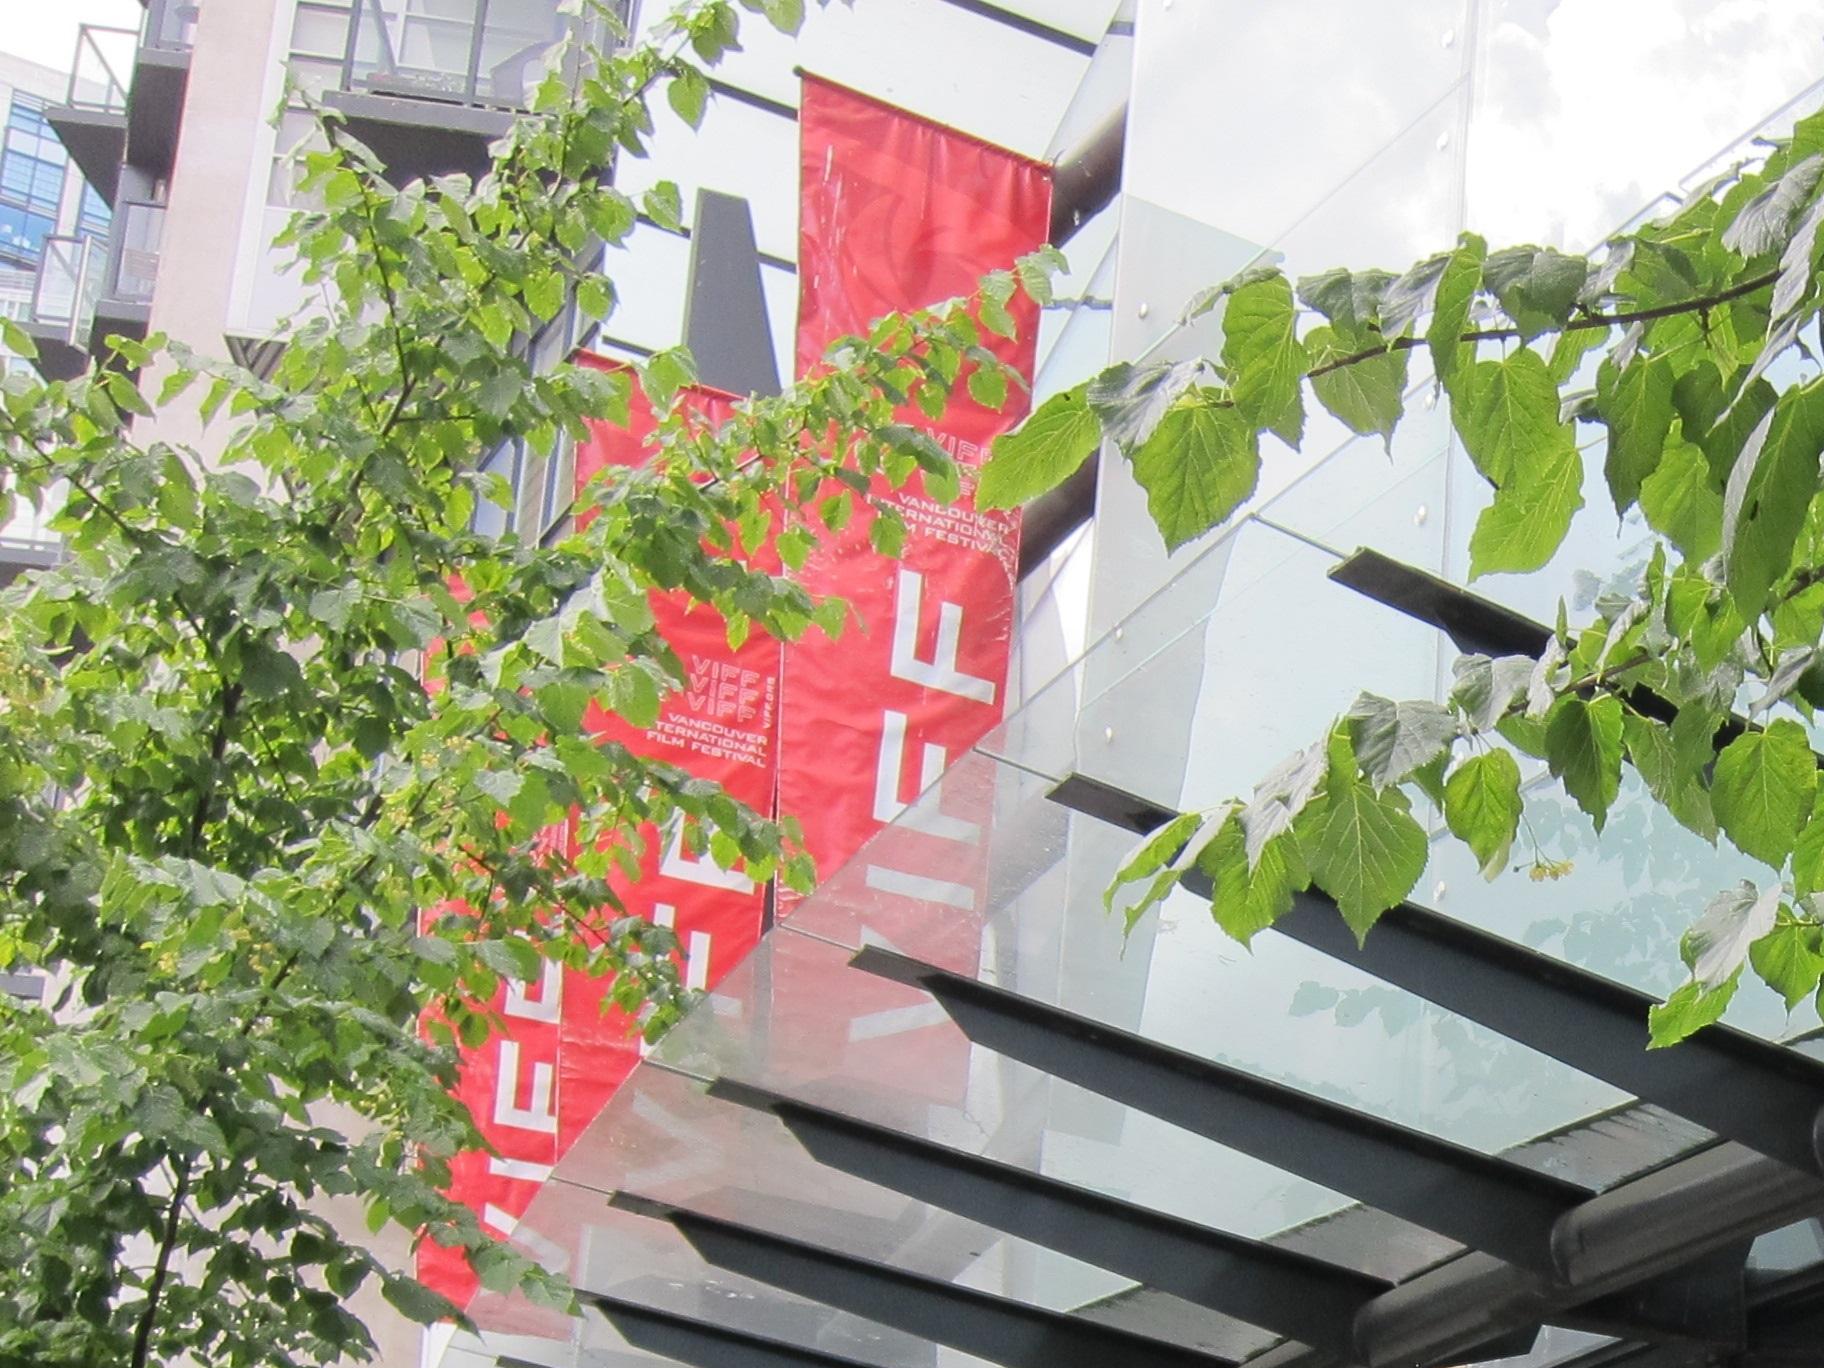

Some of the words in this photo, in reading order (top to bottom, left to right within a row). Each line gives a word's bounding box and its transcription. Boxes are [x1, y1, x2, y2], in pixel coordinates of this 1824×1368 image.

[866, 494, 1008, 549] ITERNATIONAL
[655, 720, 767, 757] TERNATIONAL
[667, 712, 768, 746] VANCOUVER
[646, 730, 685, 748] FILM
[691, 740, 766, 769] FESTIVAL
